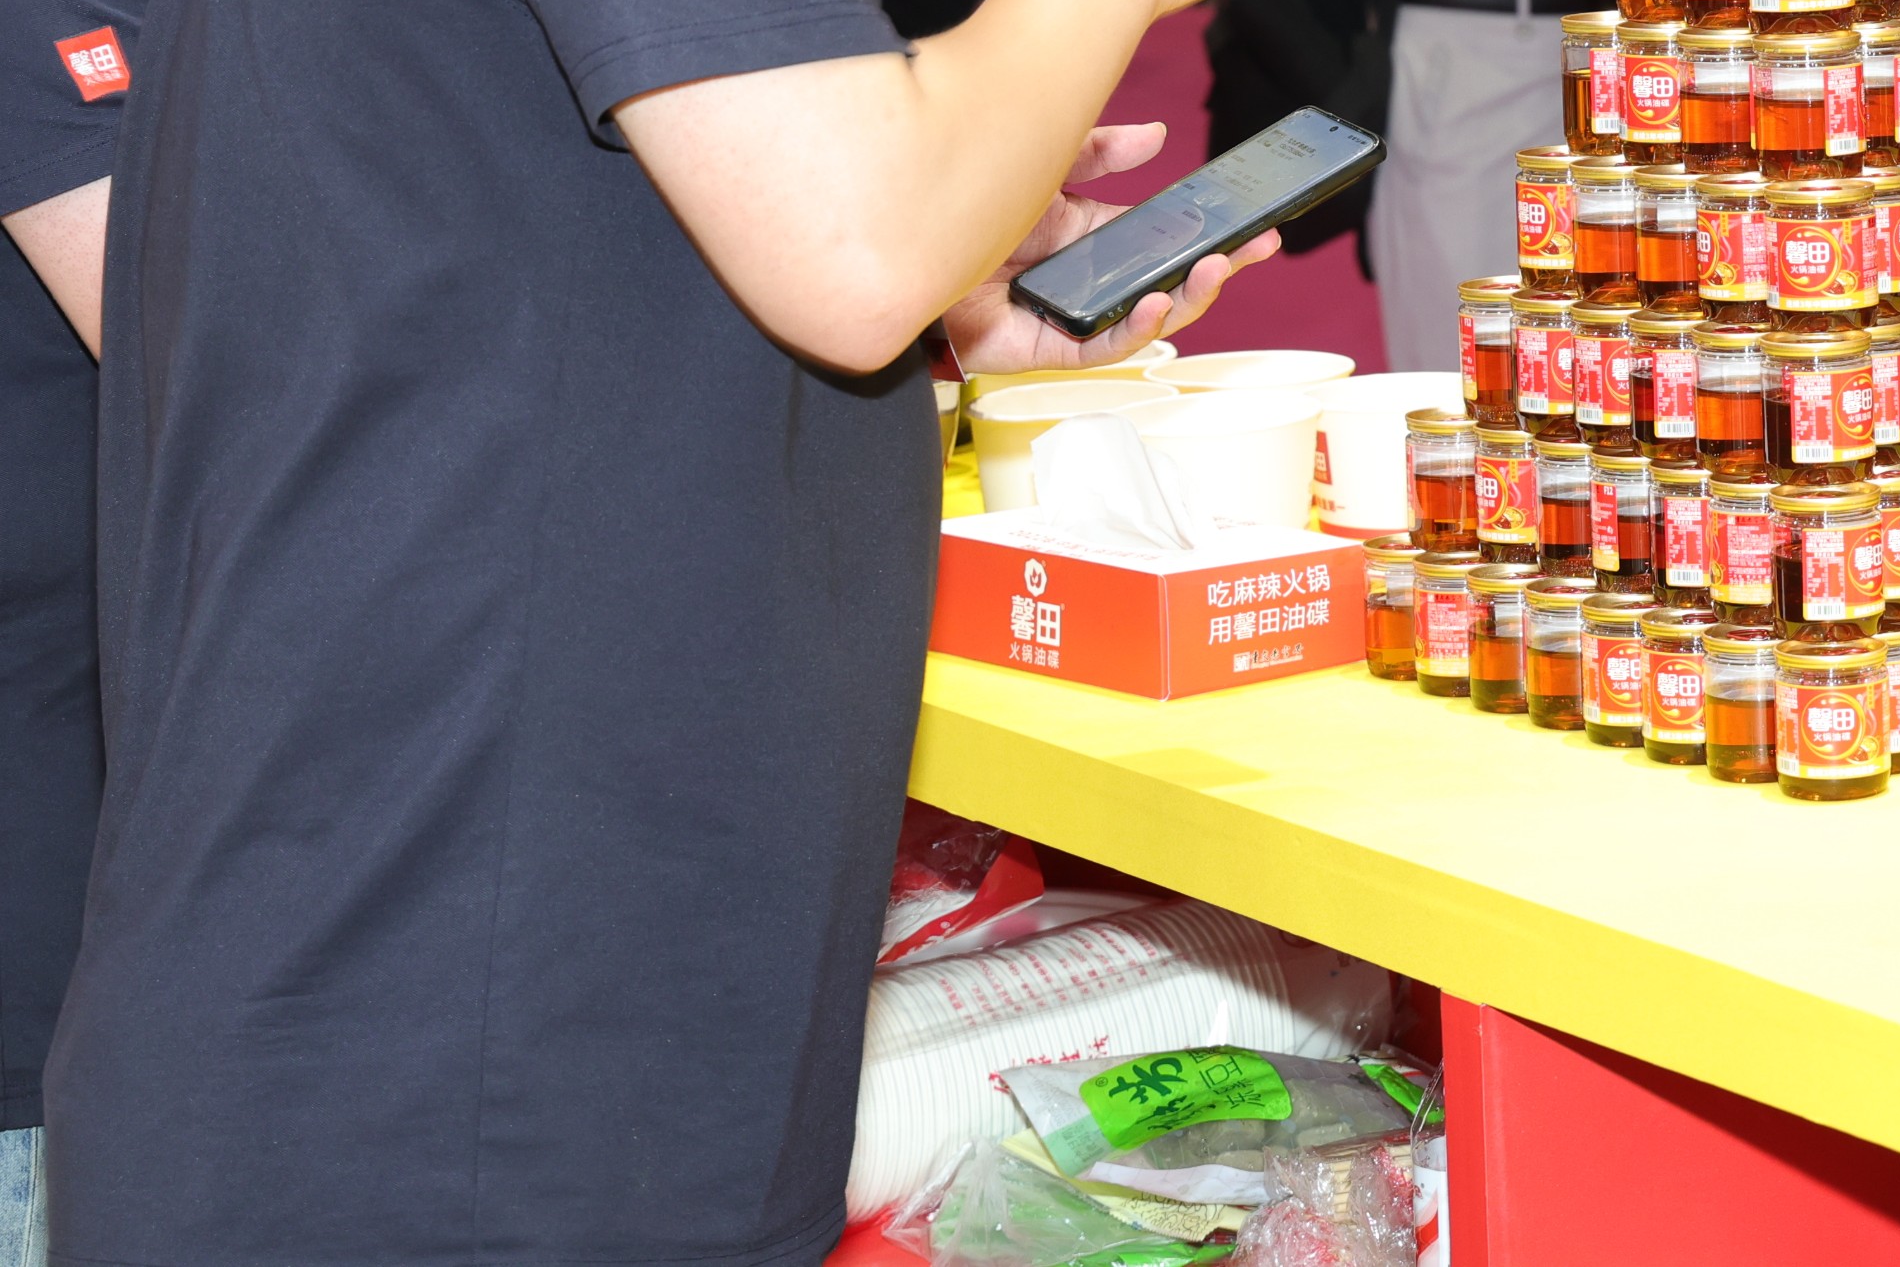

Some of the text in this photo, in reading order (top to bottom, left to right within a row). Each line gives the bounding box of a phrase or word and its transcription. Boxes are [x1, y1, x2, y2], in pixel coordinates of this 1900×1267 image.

[1633, 75, 1673, 98] 馨田
[1637, 99, 1670, 107] 火锅油碟
[1518, 201, 1546, 225] 馨田
[1785, 240, 1830, 264] 馨田
[1790, 264, 1826, 274] 火锅油碟
[1612, 358, 1629, 381] 馨
[1842, 387, 1873, 414] 馨田
[1855, 545, 1882, 571] 馨田
[1207, 564, 1331, 609] 吃麻辣火锅
[1011, 594, 1061, 647] 馨田
[1208, 598, 1330, 646] 用馨田油碟
[1009, 641, 1060, 669] 火锅油碟
[1612, 681, 1641, 691] 火锅油
[1657, 672, 1700, 697] 馨田
[1807, 707, 1855, 732] 馨田
[1813, 732, 1852, 742] 火锅油碟
